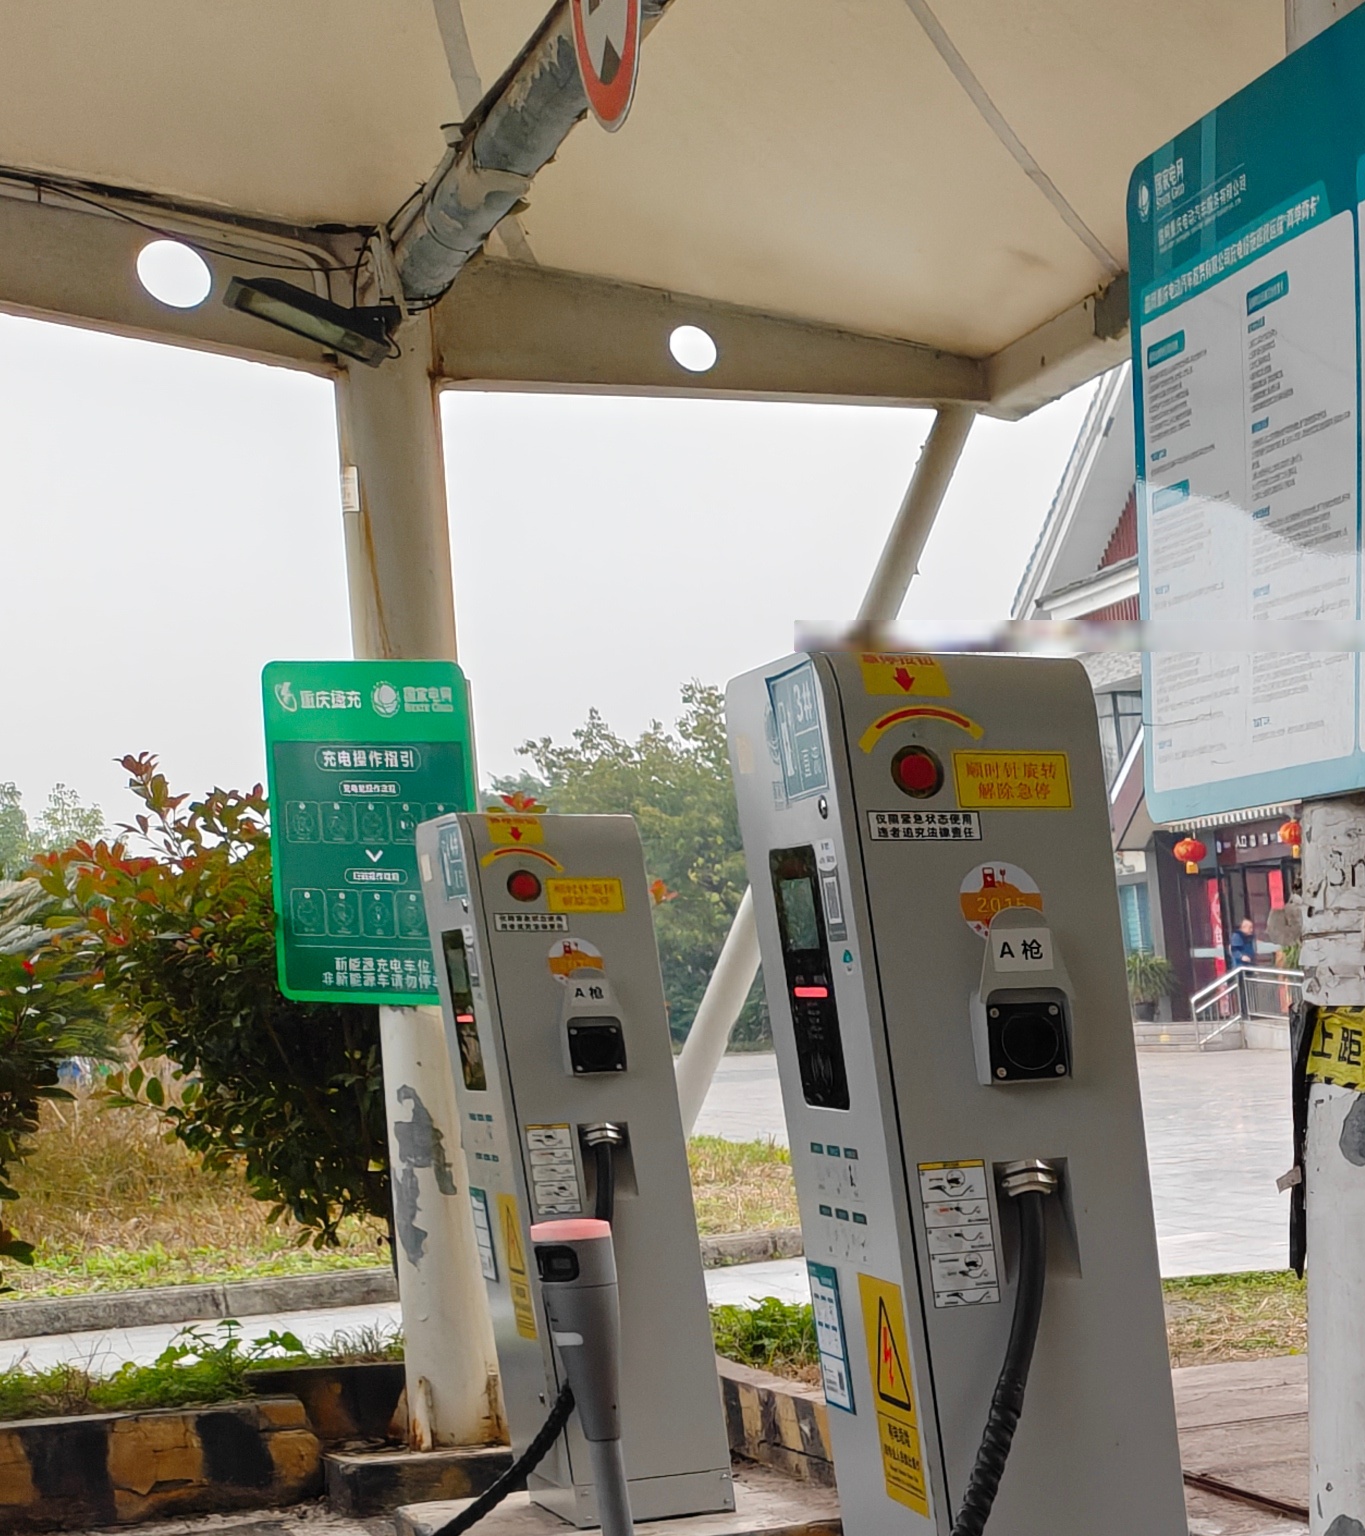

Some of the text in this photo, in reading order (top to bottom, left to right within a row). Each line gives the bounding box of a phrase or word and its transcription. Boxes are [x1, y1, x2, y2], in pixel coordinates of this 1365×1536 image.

[321, 749, 415, 769] 充电操作指引
[965, 761, 1057, 780] 顺时针旋转
[978, 782, 1051, 801] 解除急停
[999, 938, 1043, 960] A 枪
[574, 987, 585, 999] A
